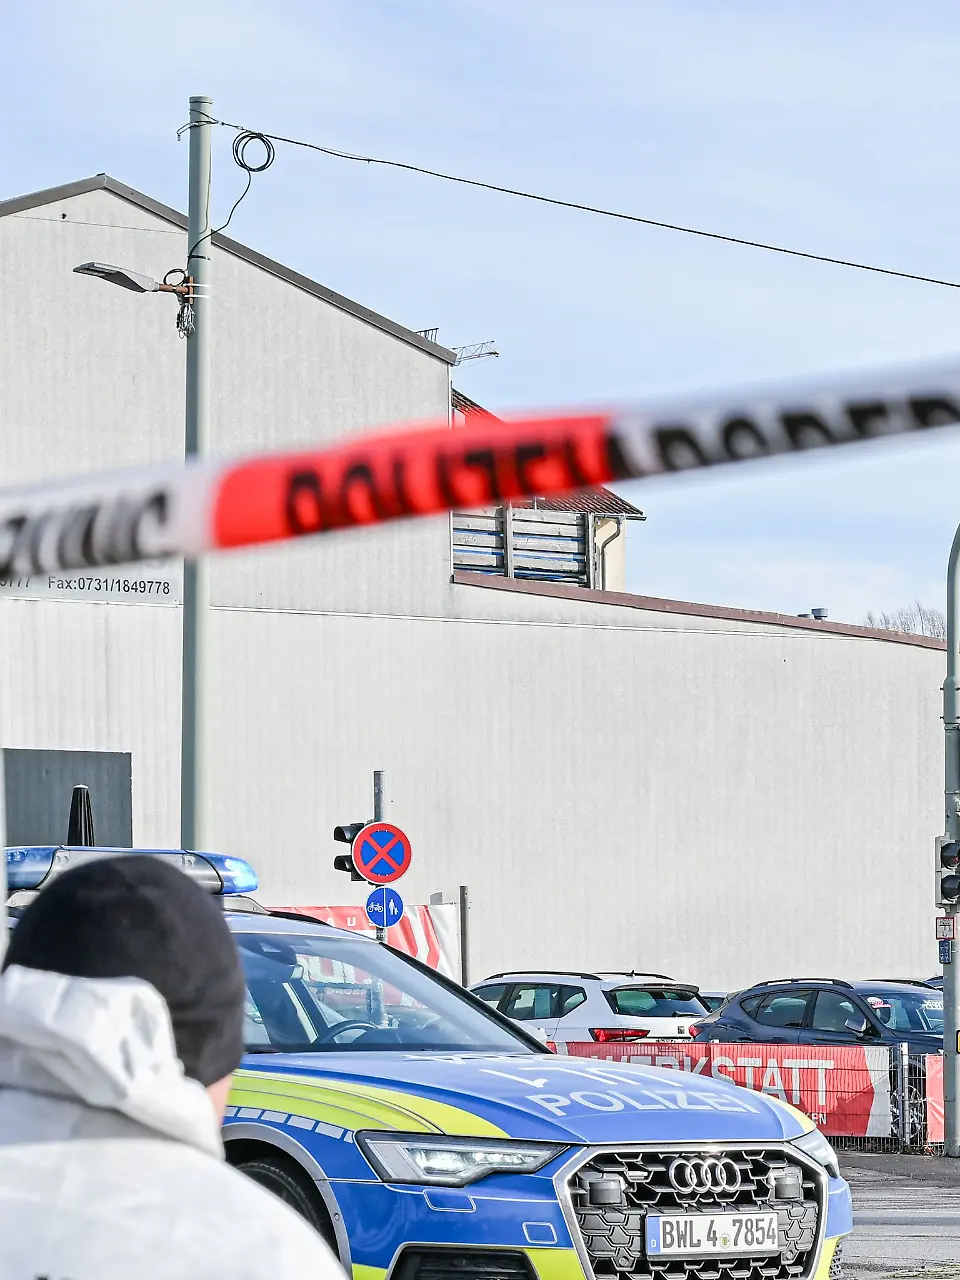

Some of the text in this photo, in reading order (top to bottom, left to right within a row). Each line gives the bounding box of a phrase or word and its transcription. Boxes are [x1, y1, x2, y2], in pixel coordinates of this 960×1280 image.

[524, 1090, 759, 1116] POLIZEI
[651, 1217, 777, 1248] D BWL 4 7854
